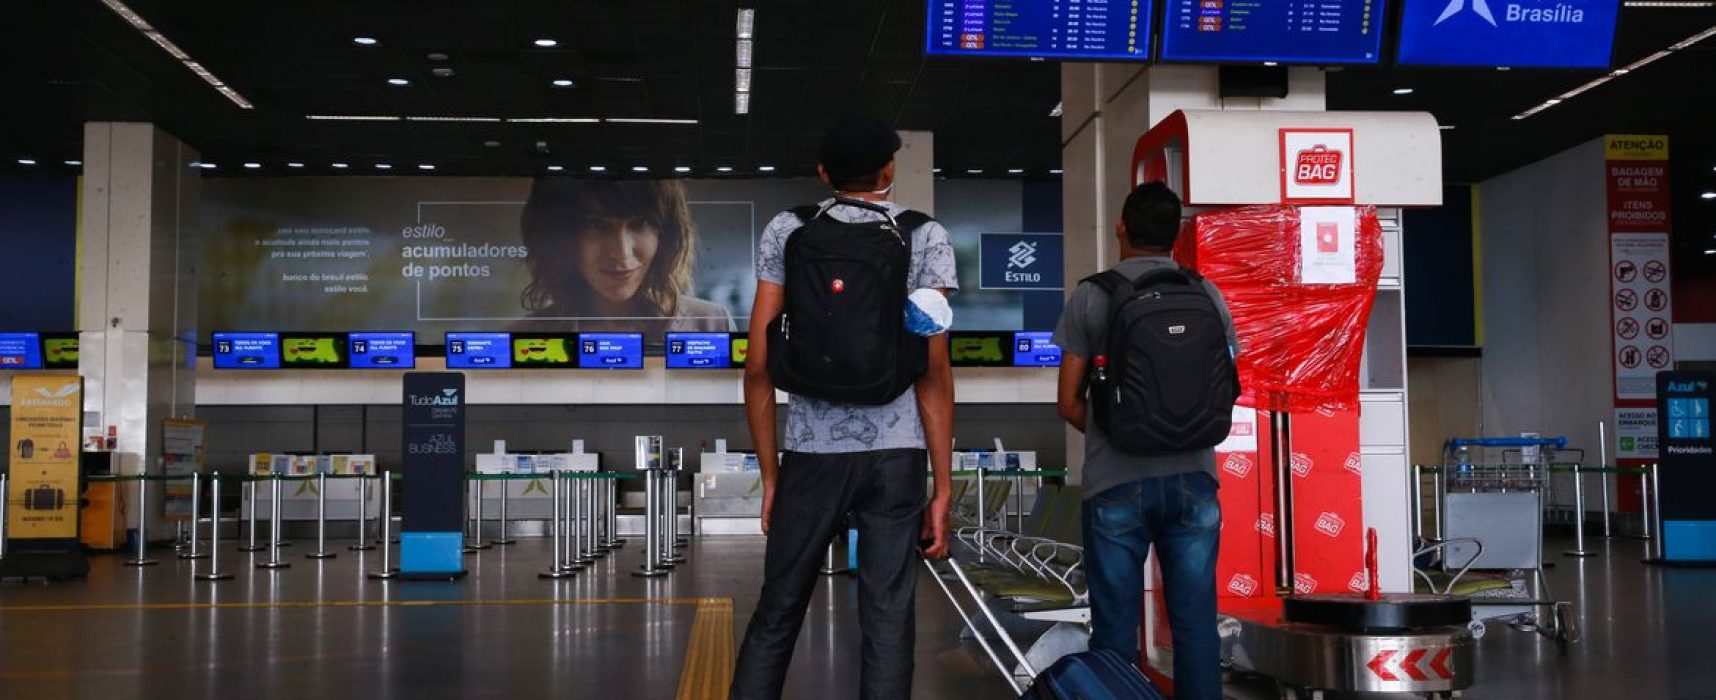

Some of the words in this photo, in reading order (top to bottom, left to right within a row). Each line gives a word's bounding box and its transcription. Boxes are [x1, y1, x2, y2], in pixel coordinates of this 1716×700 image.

[1506, 4, 1584, 23] Brasília
[1609, 139, 1664, 151] ATENÇÃO
[1300, 153, 1337, 163] PROTEC
[1298, 163, 1336, 180] BAG
[1611, 167, 1664, 177] BAGAGEM
[1617, 178, 1630, 187] DE
[1634, 176, 1658, 187] MÃO
[1624, 201, 1653, 209] ITENS
[1611, 210, 1667, 221] PROIBIDOS
[402, 242, 528, 258] acumuladores
[402, 262, 424, 278] de
[429, 262, 490, 280] pontos
[219, 345, 230, 353] 73
[355, 345, 365, 353] 74
[452, 345, 462, 353] 75
[584, 345, 594, 353] 76
[1668, 381, 1694, 392] Azul
[410, 394, 458, 406] TudoAzul
[1619, 412, 1645, 420] ACESSO
[1667, 445, 1713, 454] Prioridades
[1225, 460, 1246, 474] BAG
[1319, 519, 1338, 533] BAG
[1231, 580, 1251, 595] BAG
